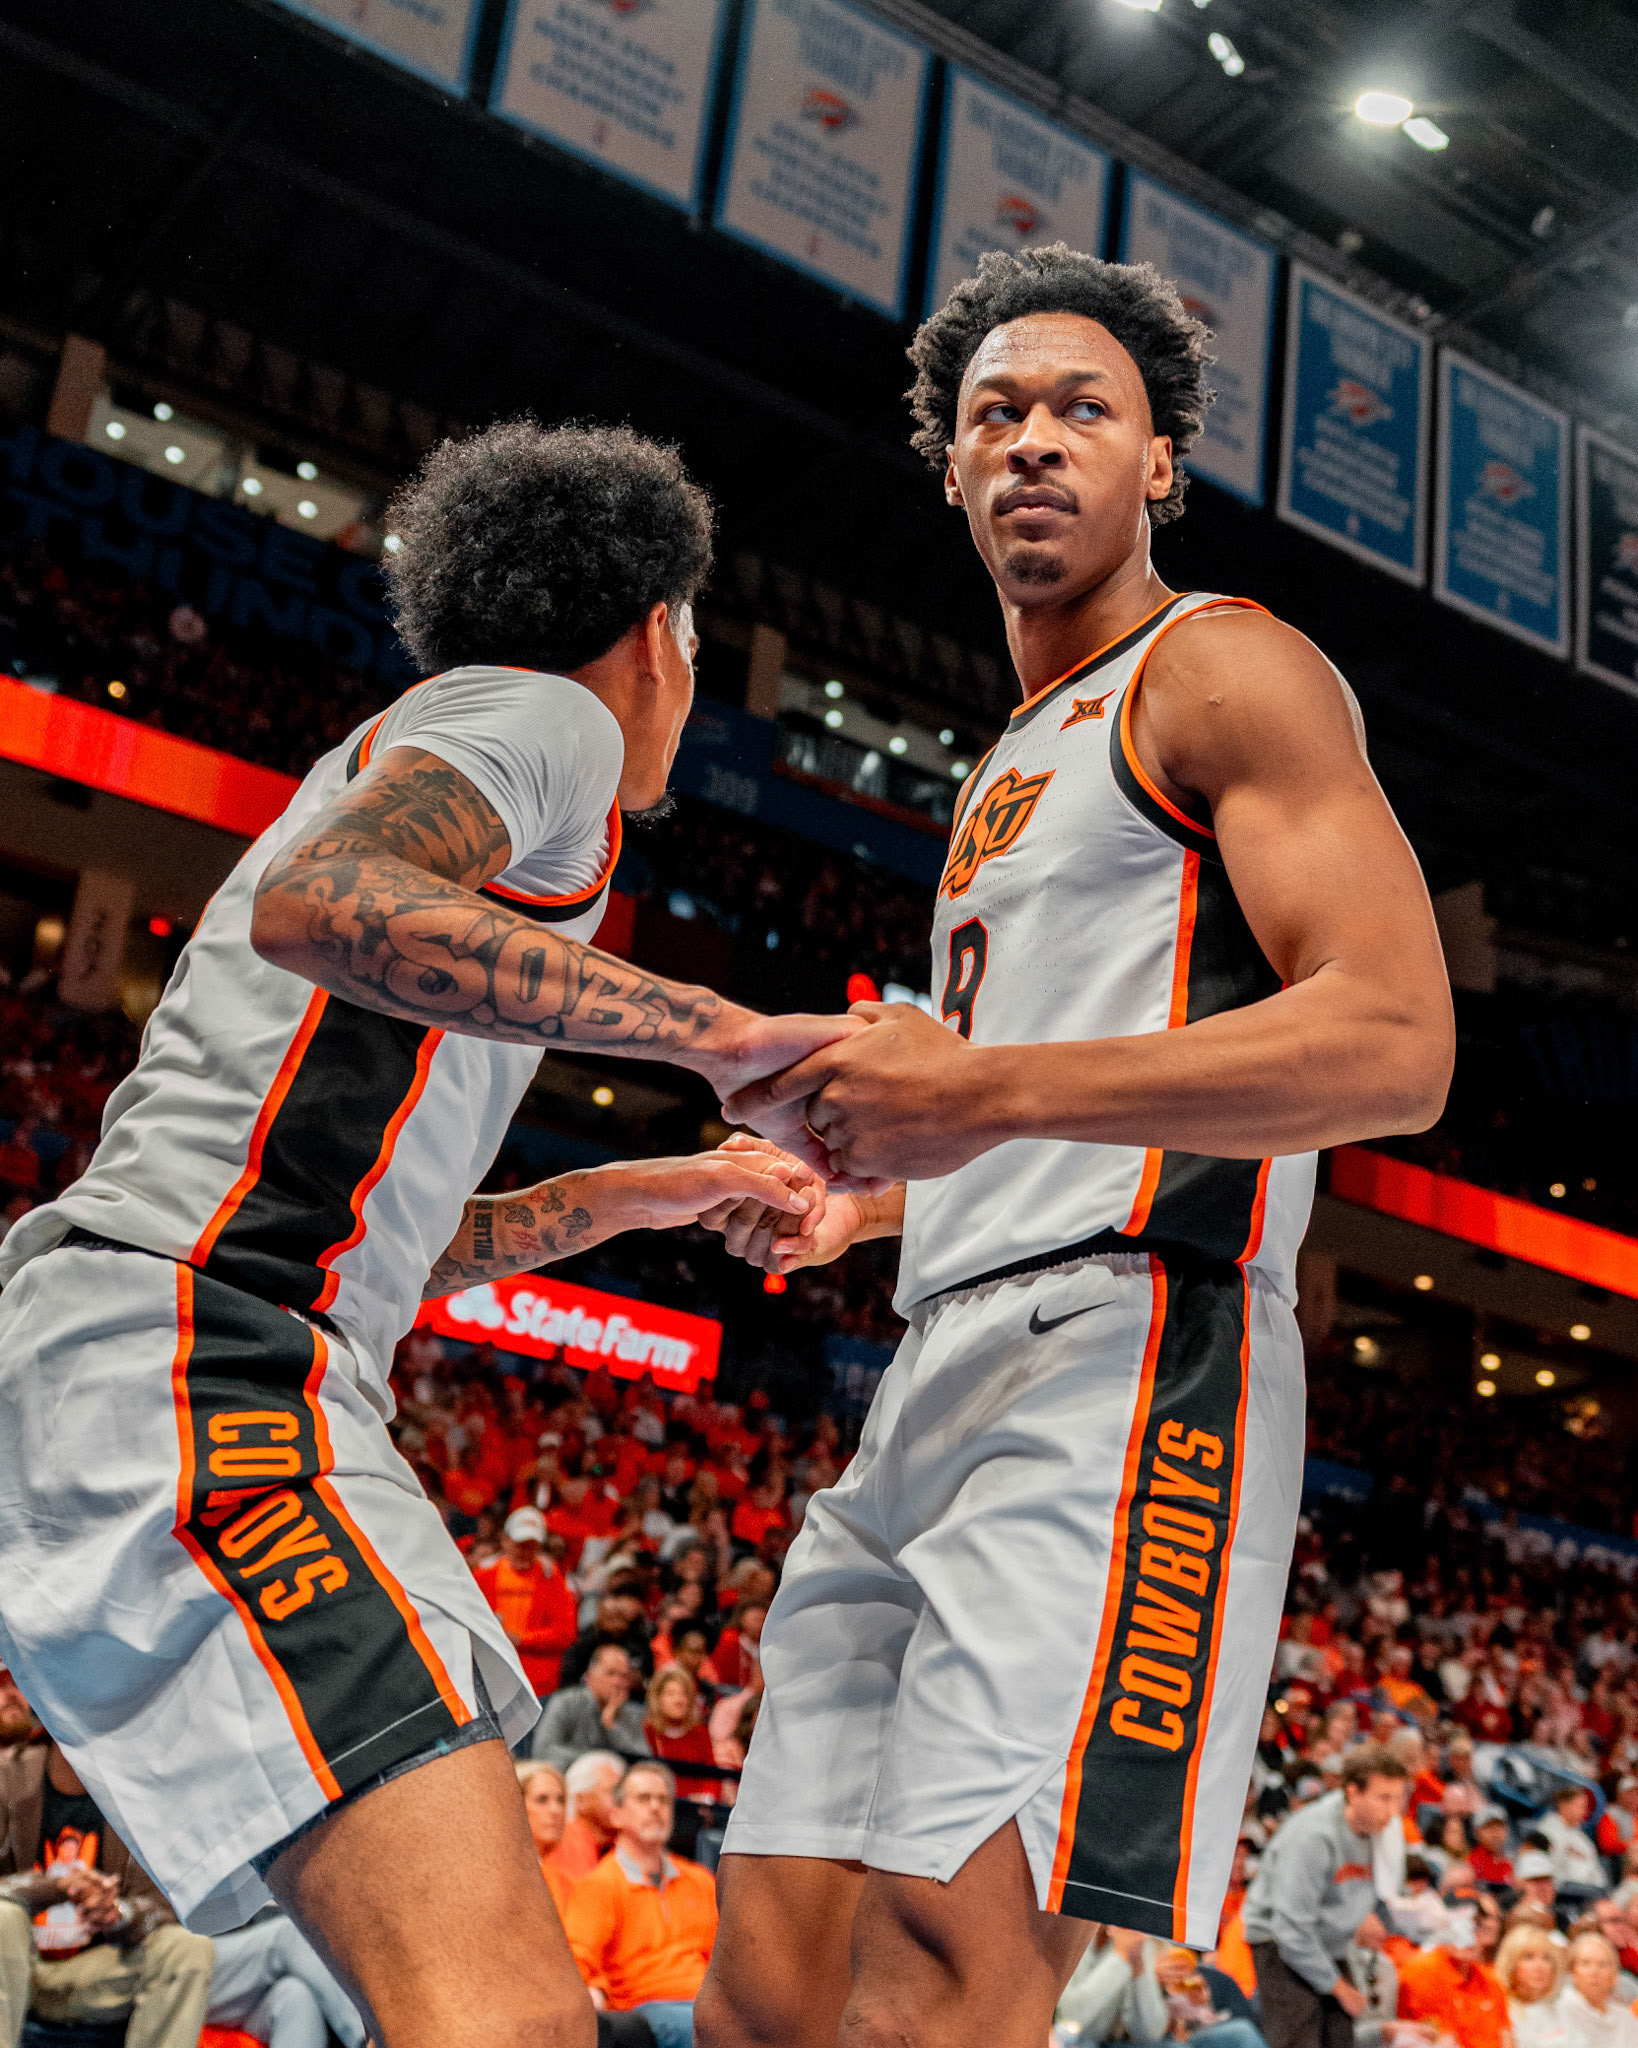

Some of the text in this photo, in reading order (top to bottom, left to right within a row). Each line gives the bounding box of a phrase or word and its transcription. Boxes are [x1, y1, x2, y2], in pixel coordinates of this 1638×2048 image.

[941, 916, 988, 1040] 9
[200, 1410, 349, 1621] COOYS
[1109, 1418, 1224, 1752] COWBOYS
